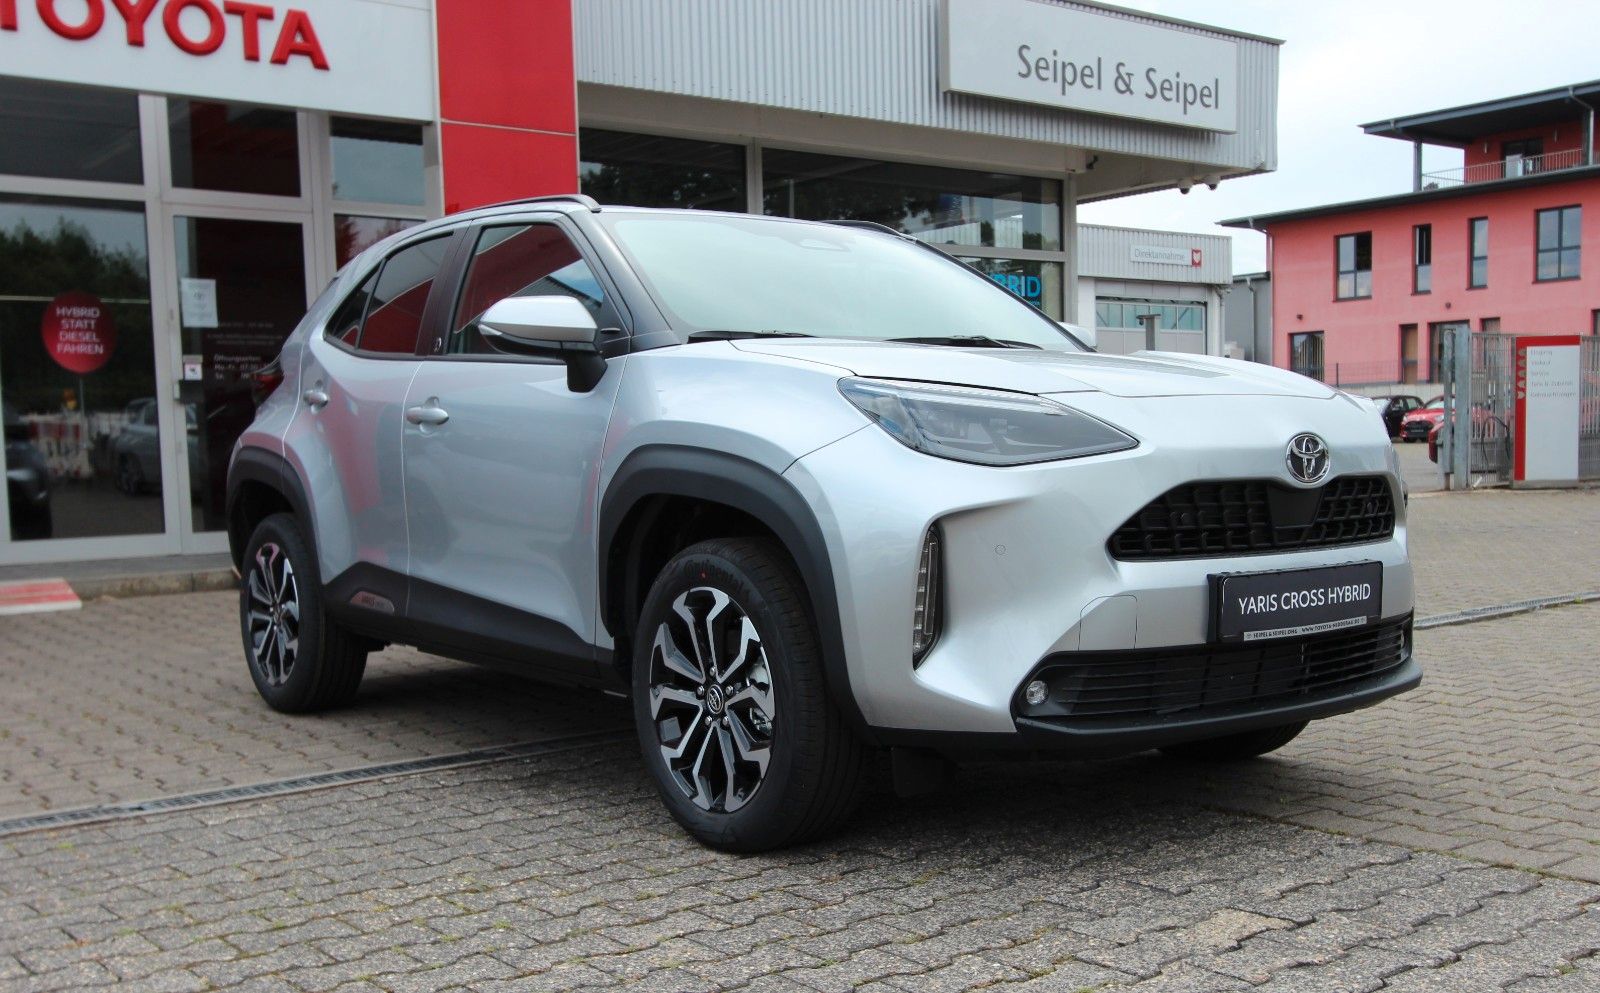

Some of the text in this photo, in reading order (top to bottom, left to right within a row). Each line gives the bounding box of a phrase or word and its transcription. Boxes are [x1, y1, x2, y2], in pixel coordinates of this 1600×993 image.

[1018, 44, 1219, 115] Seipel & Seipel
[56, 306, 100, 318] HYBRID
[61, 318, 96, 330] STATT
[59, 330, 100, 342] DIESEL
[56, 343, 104, 354] FAHREN
[1239, 583, 1371, 615] YARIS CROSS HYBRID
